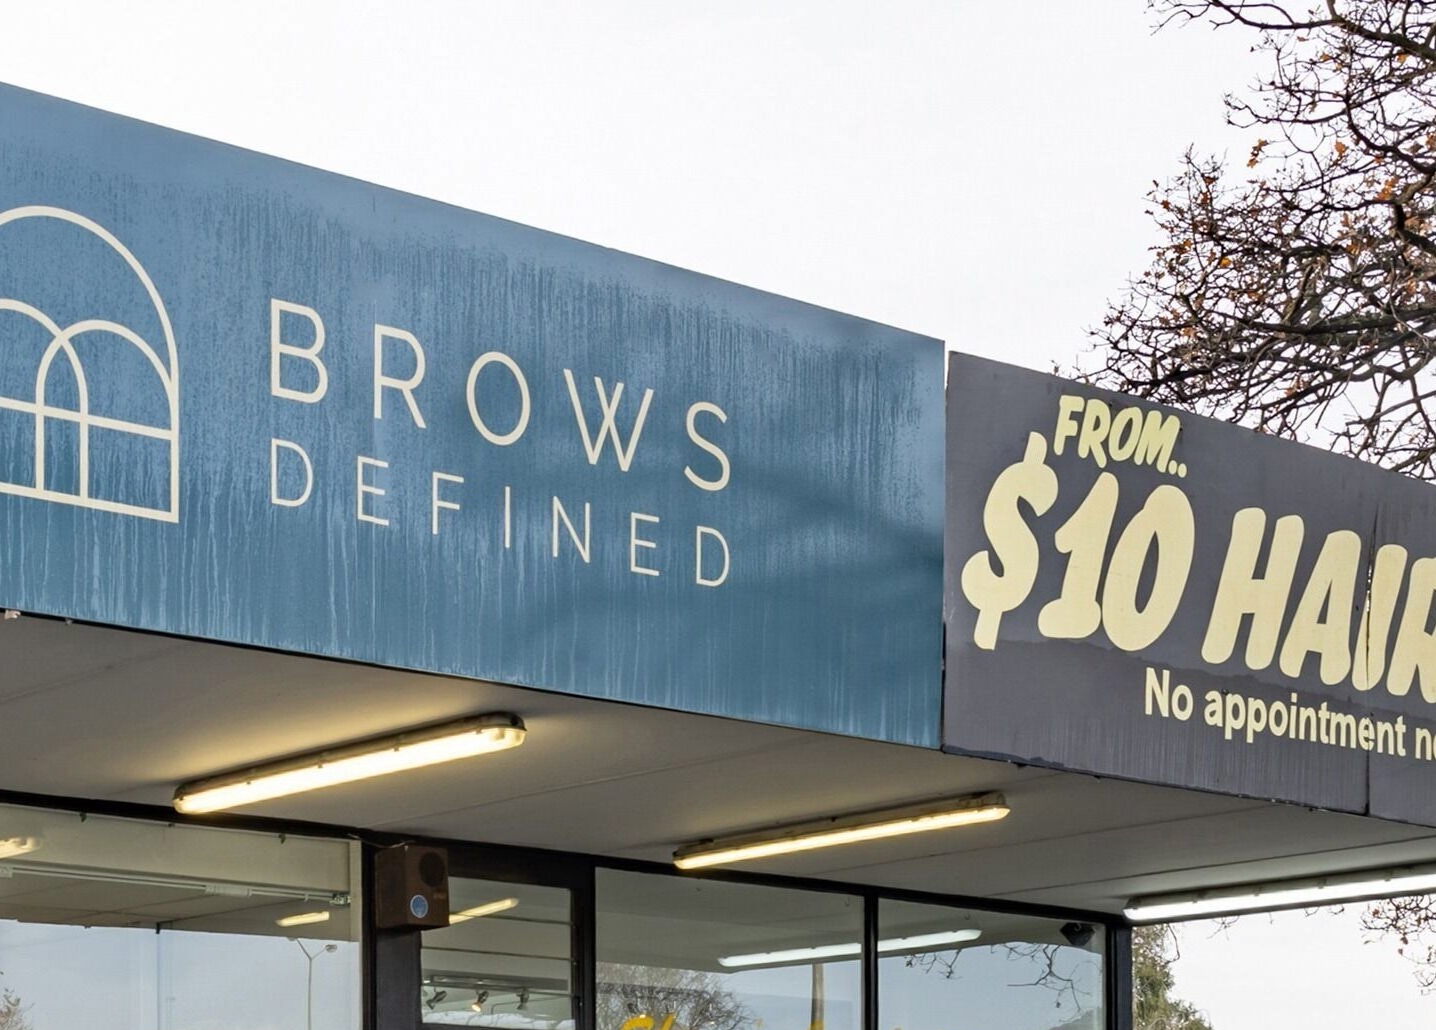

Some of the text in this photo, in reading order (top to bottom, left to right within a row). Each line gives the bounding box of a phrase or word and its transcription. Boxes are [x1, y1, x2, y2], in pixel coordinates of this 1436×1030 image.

[271, 298, 731, 492] BROWS
[1054, 395, 1188, 478] FROM..
[271, 437, 731, 588] DEFINED
[961, 431, 1195, 652] $10
[1145, 667, 1436, 760] No appointment n
